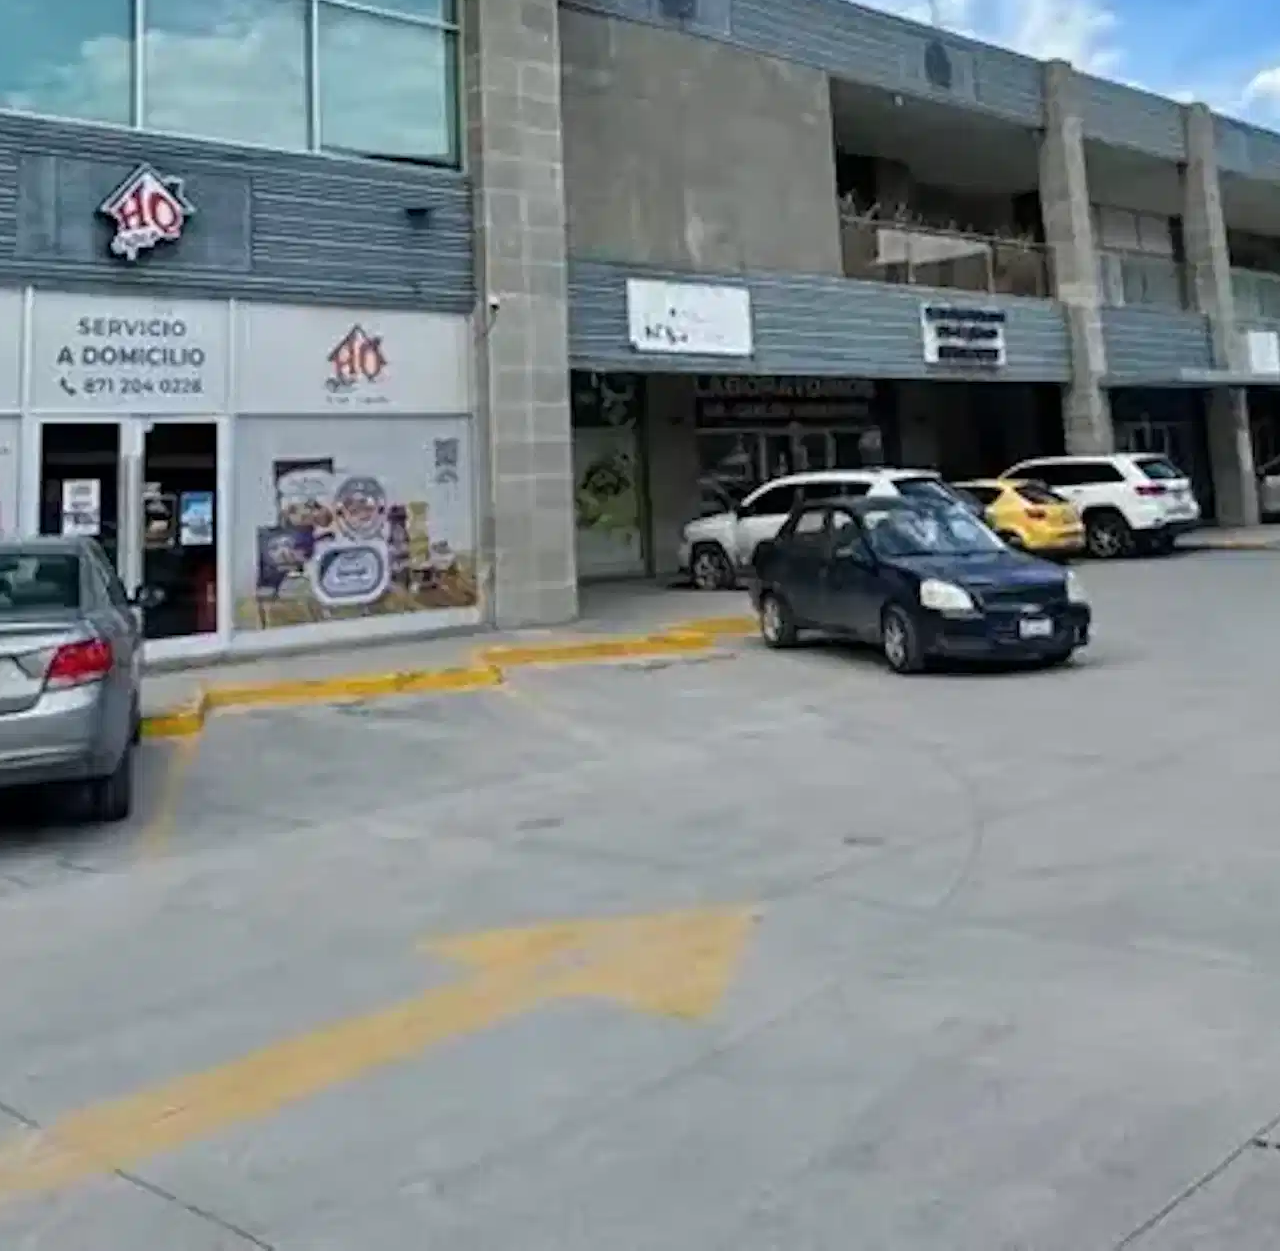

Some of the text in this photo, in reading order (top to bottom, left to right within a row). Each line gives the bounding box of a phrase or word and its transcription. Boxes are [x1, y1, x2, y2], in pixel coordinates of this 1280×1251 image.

[76, 316, 186, 337] SERVICIO
[56, 345, 205, 367] A DOMICILIO
[83, 376, 114, 394] 871
